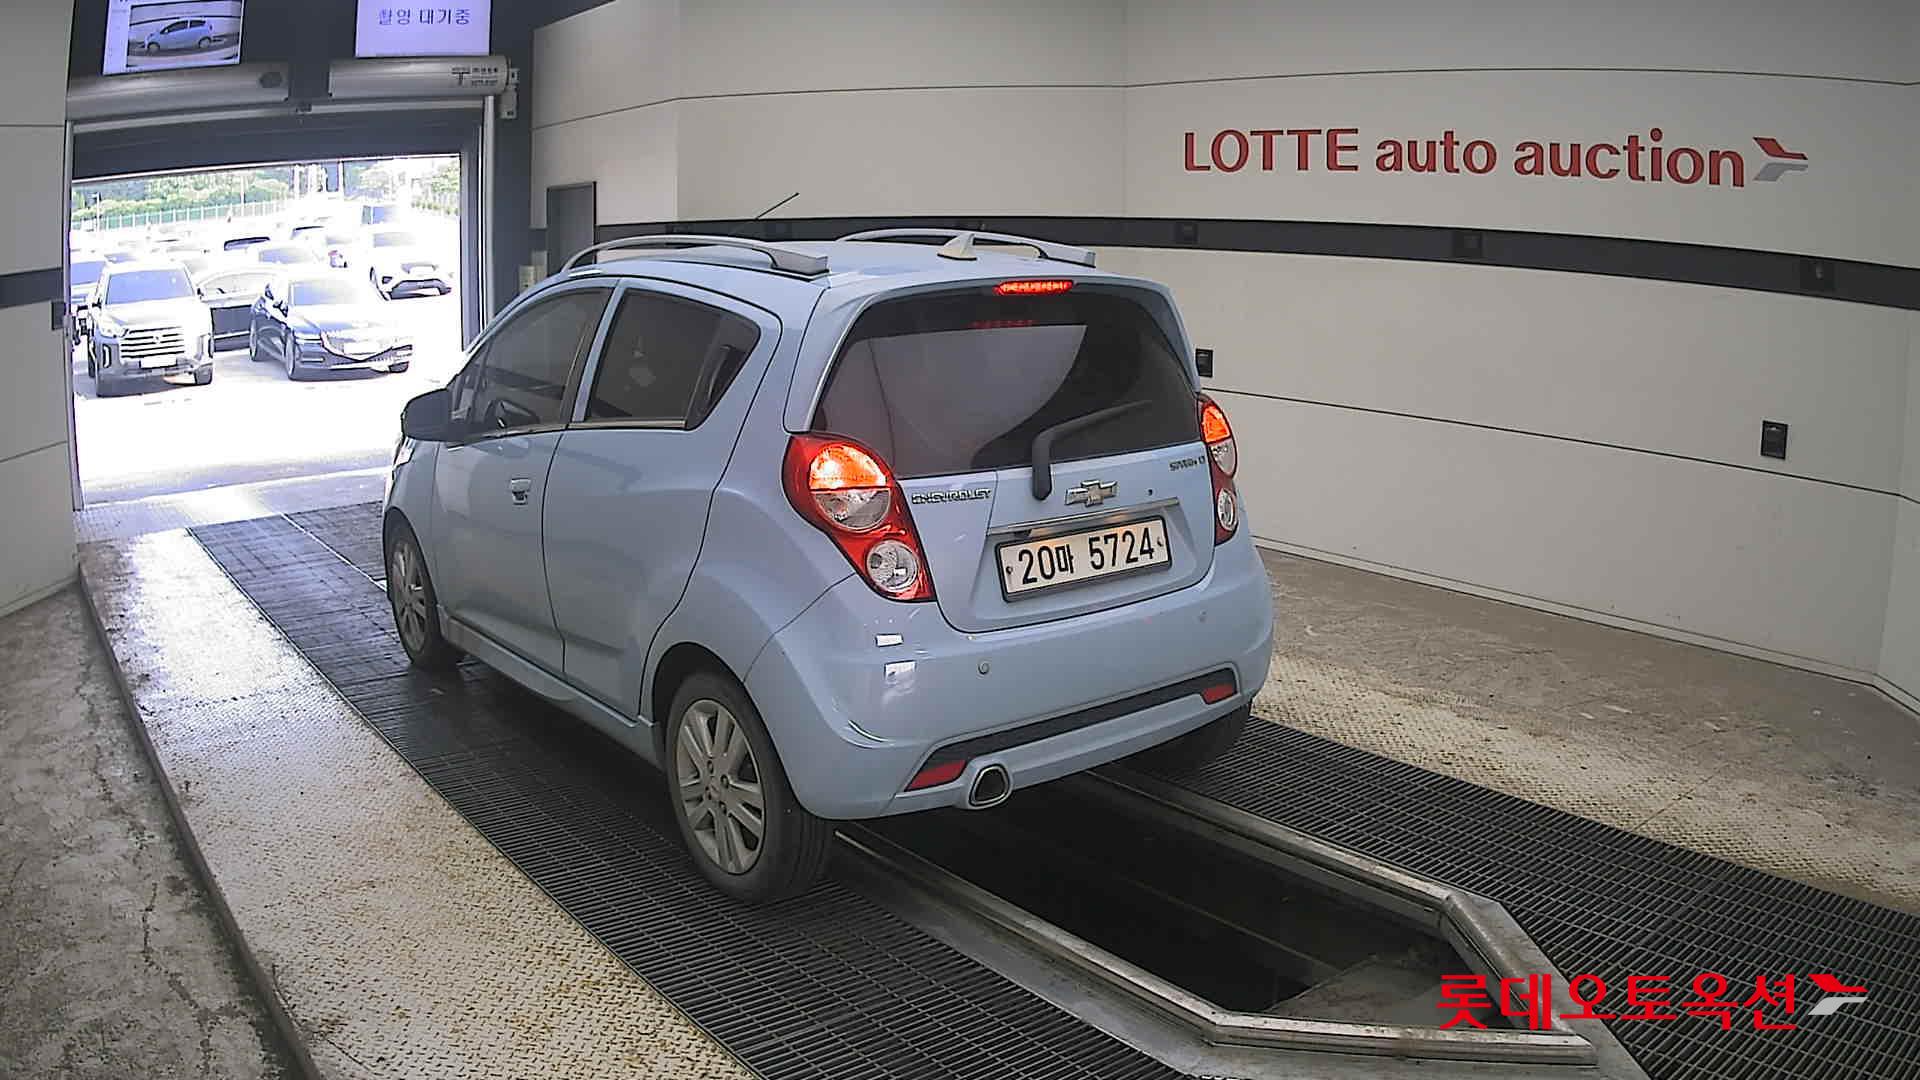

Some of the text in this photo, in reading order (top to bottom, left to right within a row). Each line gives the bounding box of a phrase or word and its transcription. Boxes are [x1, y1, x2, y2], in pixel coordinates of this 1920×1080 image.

[419, 8, 471, 25] 대기중
[1184, 127, 1744, 188] LOTTE auto auction
[1018, 527, 1155, 585] 20마 5724
